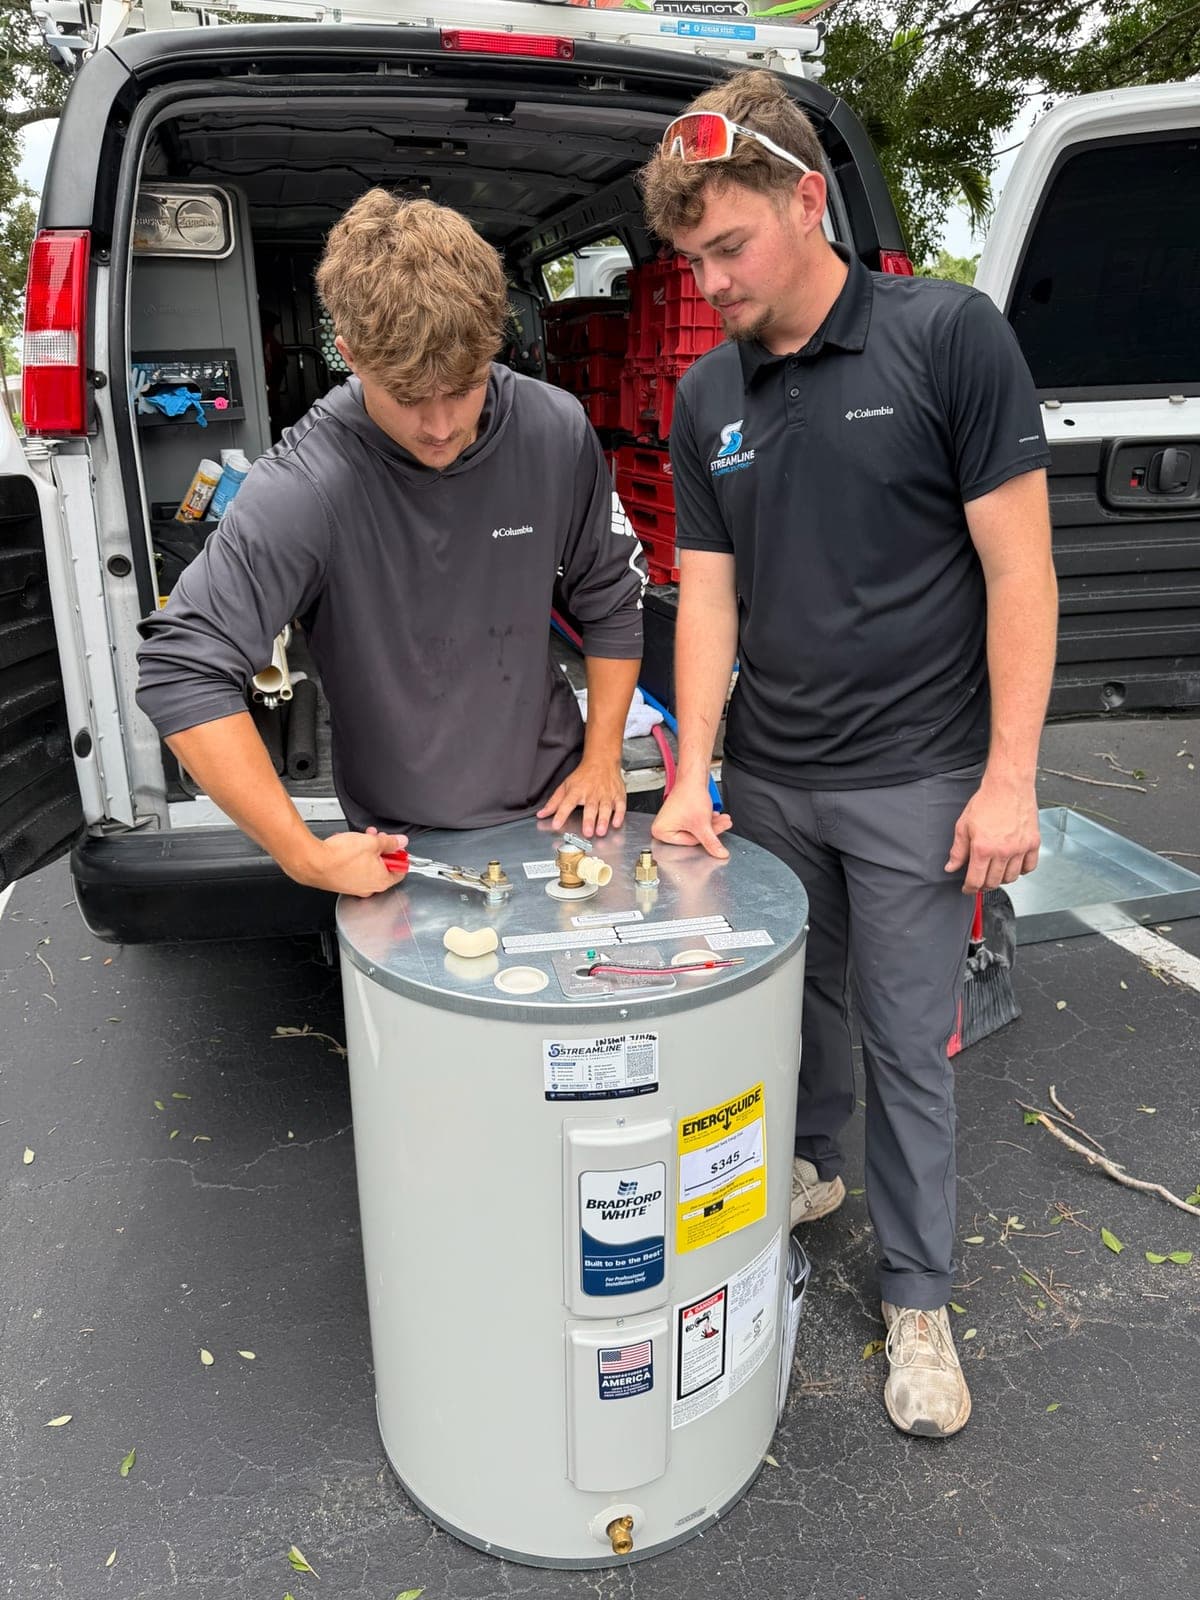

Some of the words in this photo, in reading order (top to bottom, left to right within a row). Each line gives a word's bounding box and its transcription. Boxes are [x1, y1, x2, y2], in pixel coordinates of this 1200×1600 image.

[654, 4, 733, 14] LOUISVILLE
[854, 406, 894, 419] Columbia
[710, 449, 755, 471] STREAMLINE
[499, 525, 533, 537] Columbia
[560, 1044, 622, 1055] STREAMLINE
[682, 1088, 762, 1137] ENERGYGUIDE
[710, 1150, 740, 1174] $345
[586, 1190, 662, 1209] BRADFORD
[601, 1204, 647, 1221] WHITE
[584, 1259, 603, 1267] Built
[615, 1258, 626, 1266] be
[628, 1256, 641, 1264] the
[601, 1371, 651, 1388] AMERICA
